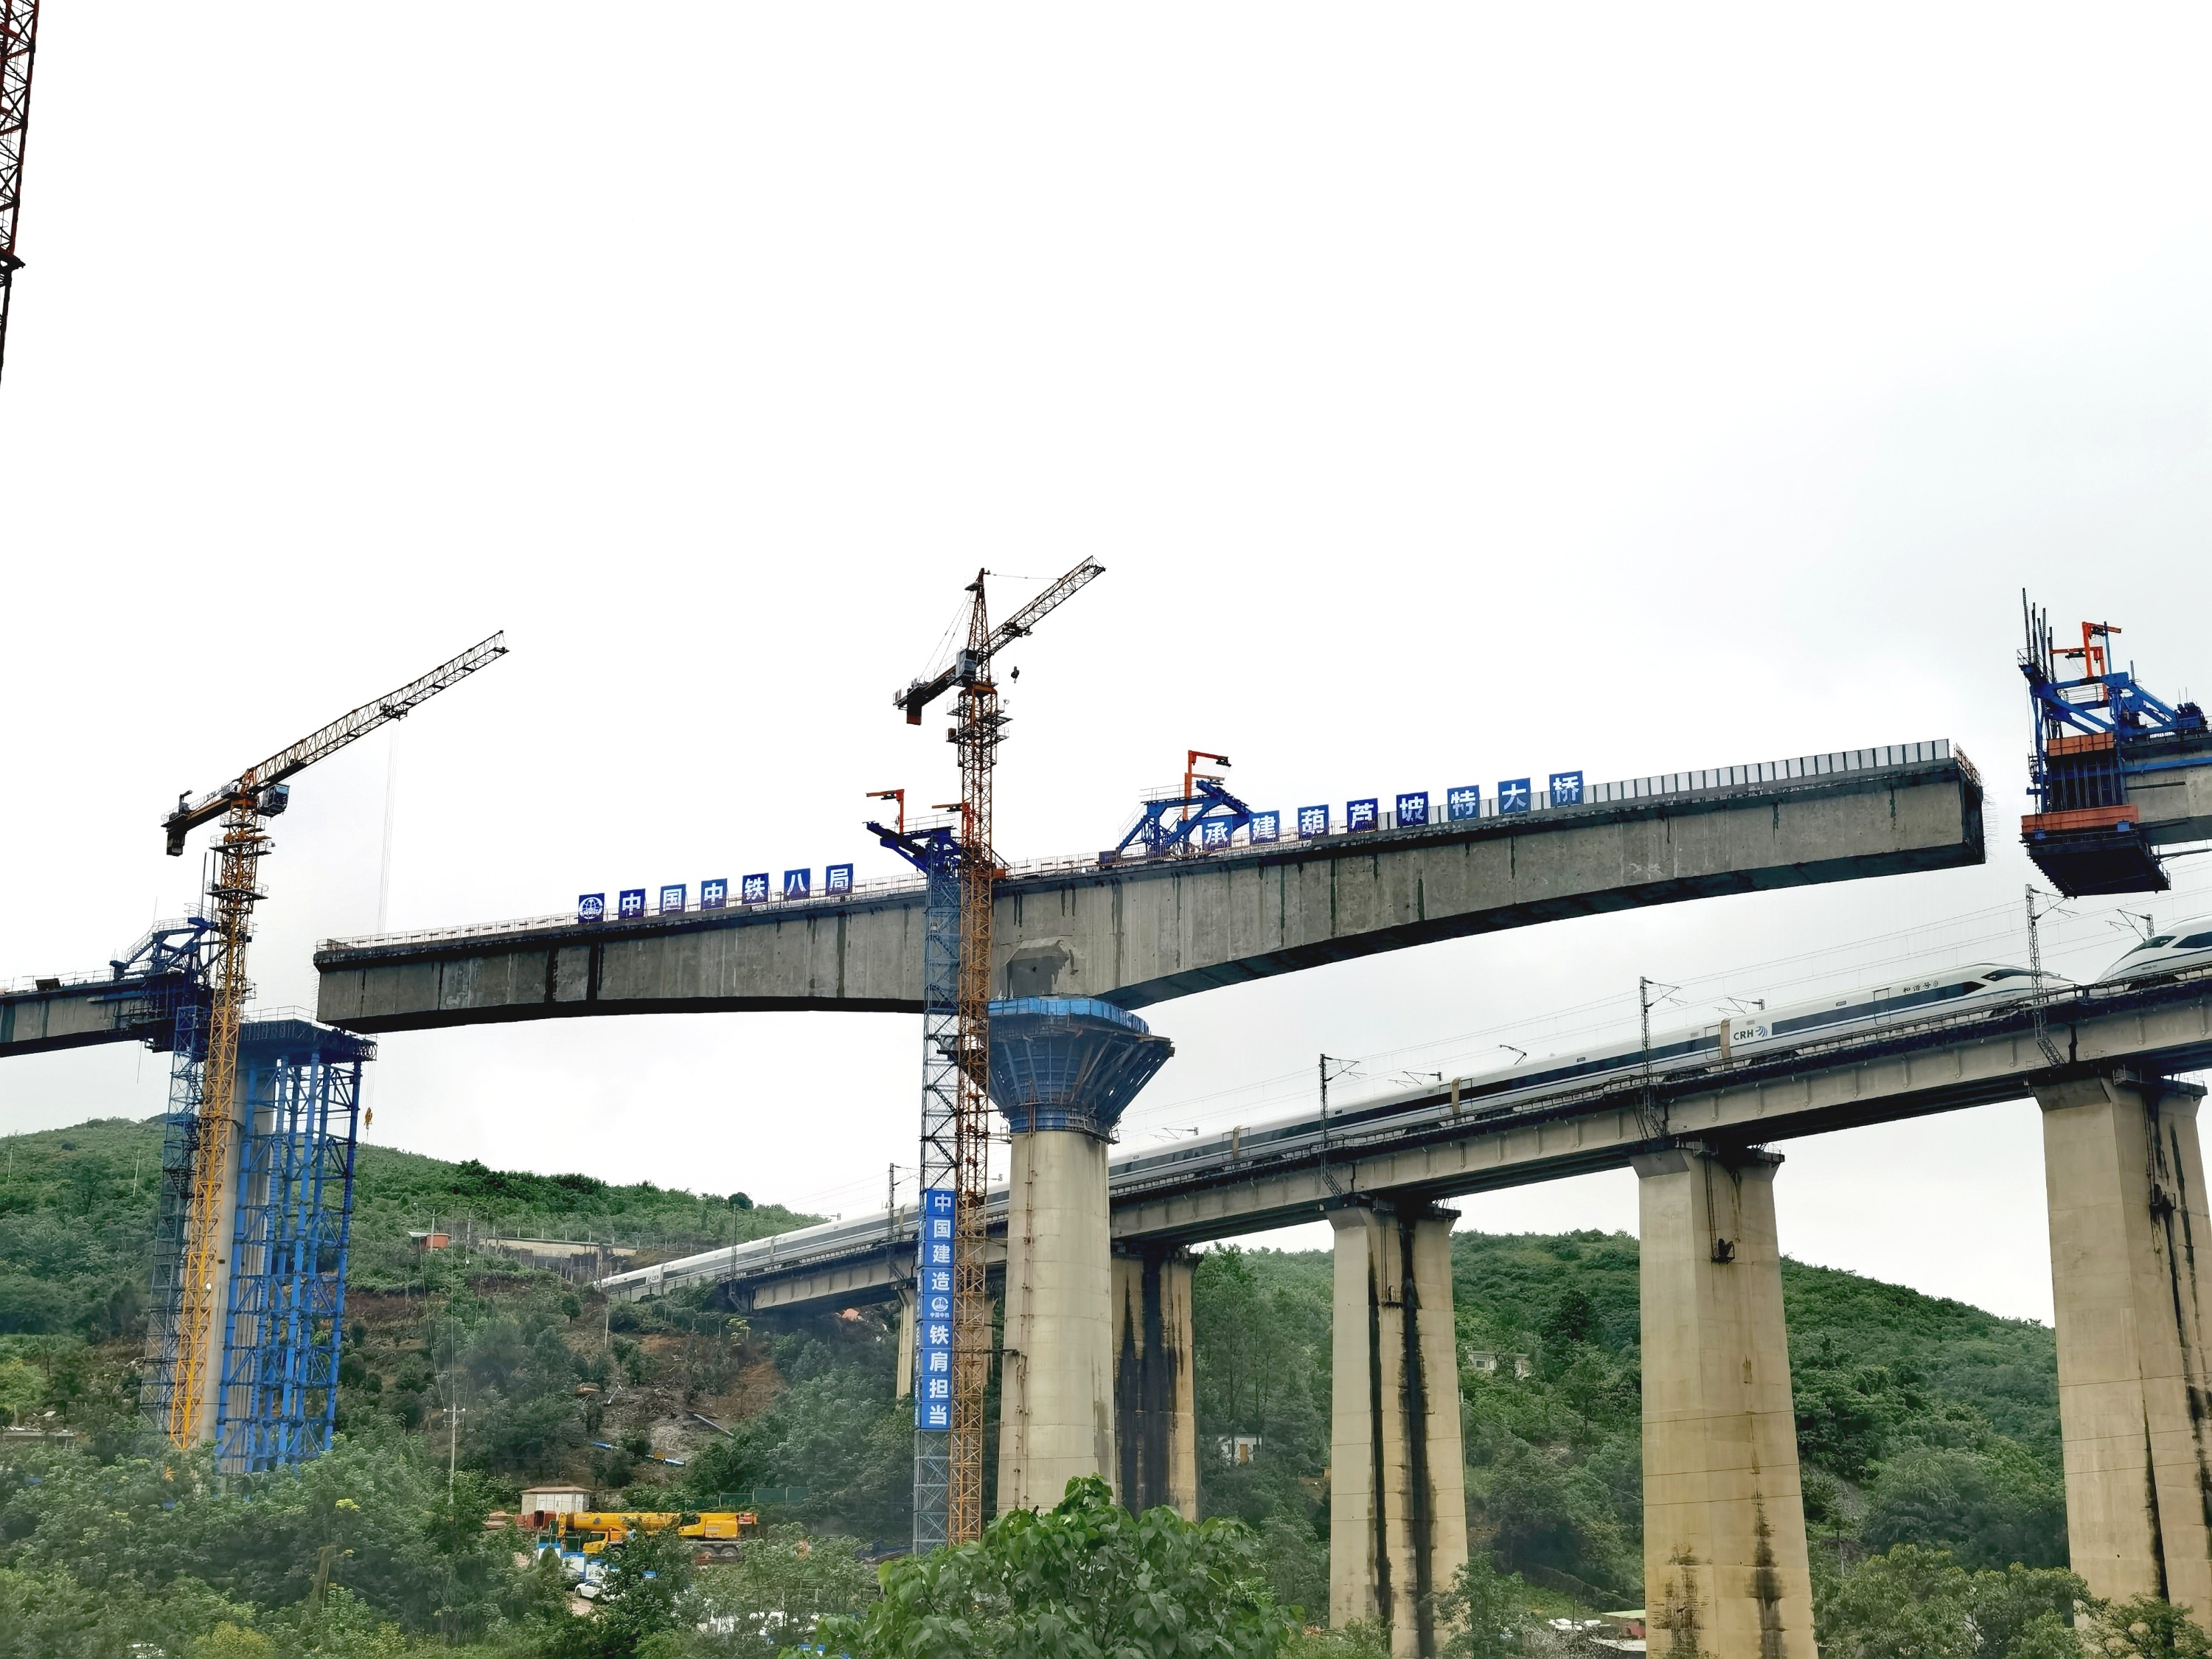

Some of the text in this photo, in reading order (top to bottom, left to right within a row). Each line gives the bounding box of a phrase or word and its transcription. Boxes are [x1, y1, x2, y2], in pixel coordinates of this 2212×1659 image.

[1205, 776, 1579, 846] 承建葫芦坡特大桥
[622, 868, 849, 915] 中国中铁八局
[1733, 1029, 1753, 1040] CRH
[931, 1193, 951, 1291] 中国建造
[929, 1324, 949, 1425] 铁肩担当
